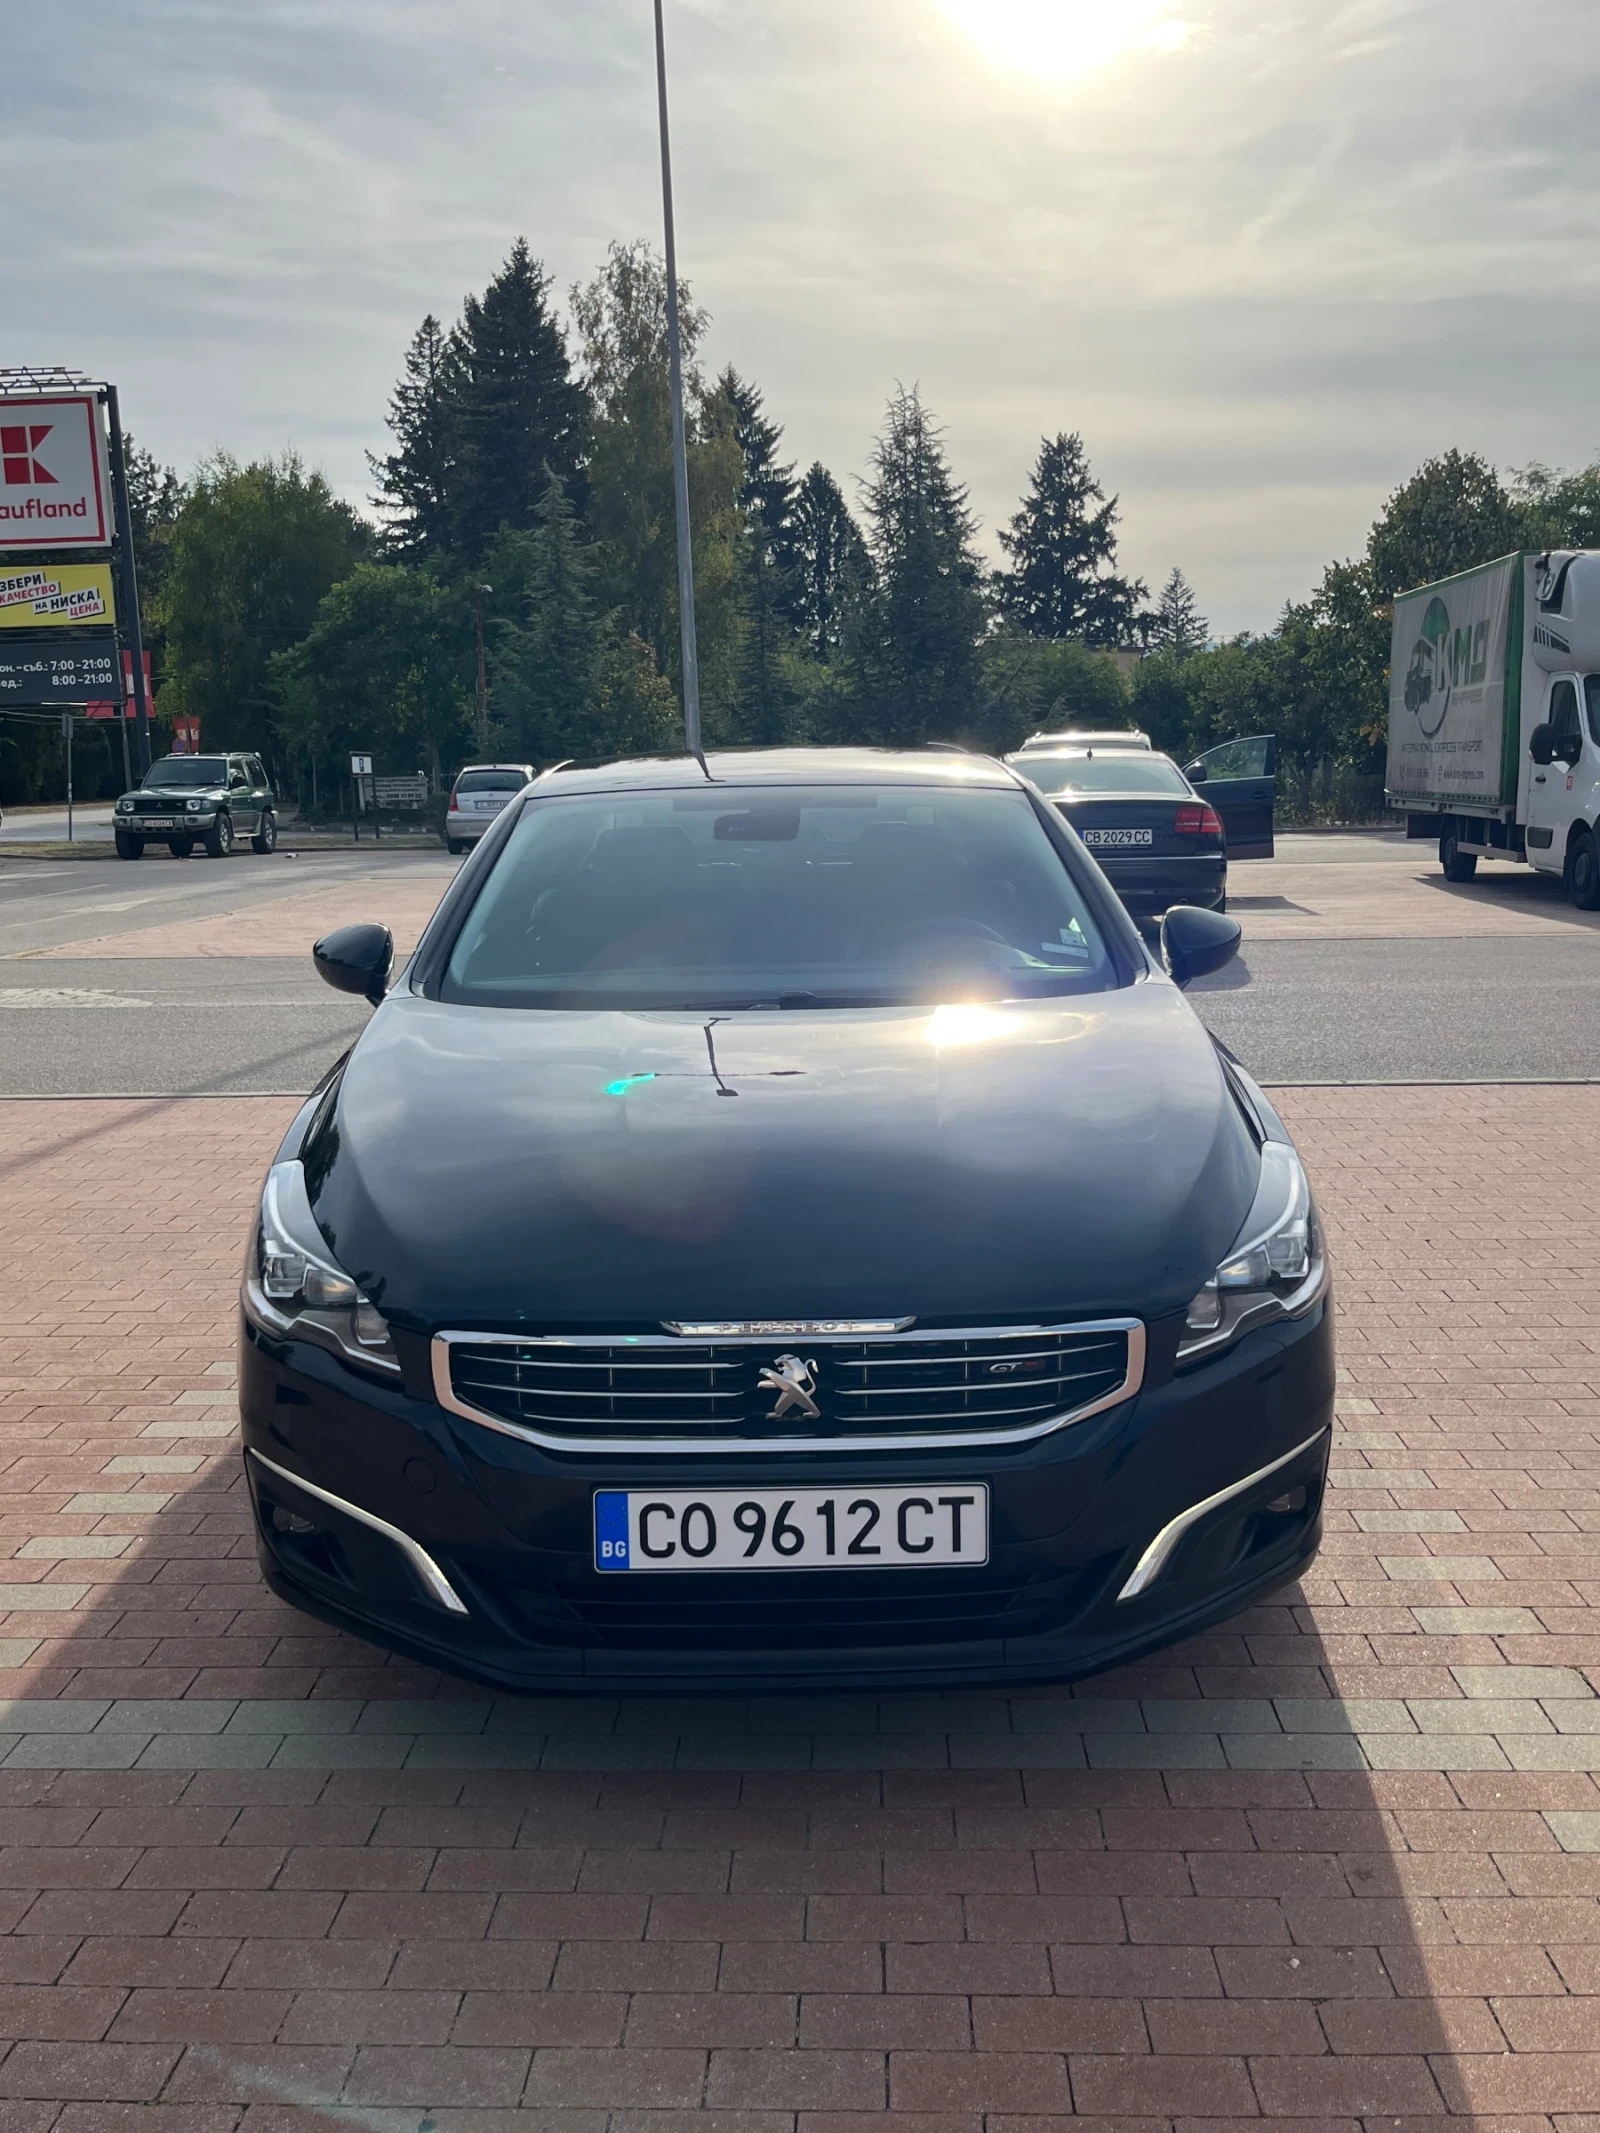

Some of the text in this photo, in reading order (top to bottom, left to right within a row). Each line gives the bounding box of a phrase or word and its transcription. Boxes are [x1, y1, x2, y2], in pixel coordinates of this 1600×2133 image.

[0, 584, 57, 604] КАЧЕСТВО
[35, 590, 95, 610] НА НИСКА
[70, 602, 100, 617] ЦЕНА
[0, 679, 23, 689] ед.:
[1085, 831, 1150, 844] CB 2029 CC
[989, 1361, 1023, 1373] GT
[601, 1496, 975, 1559] BG CO 9612 CT
